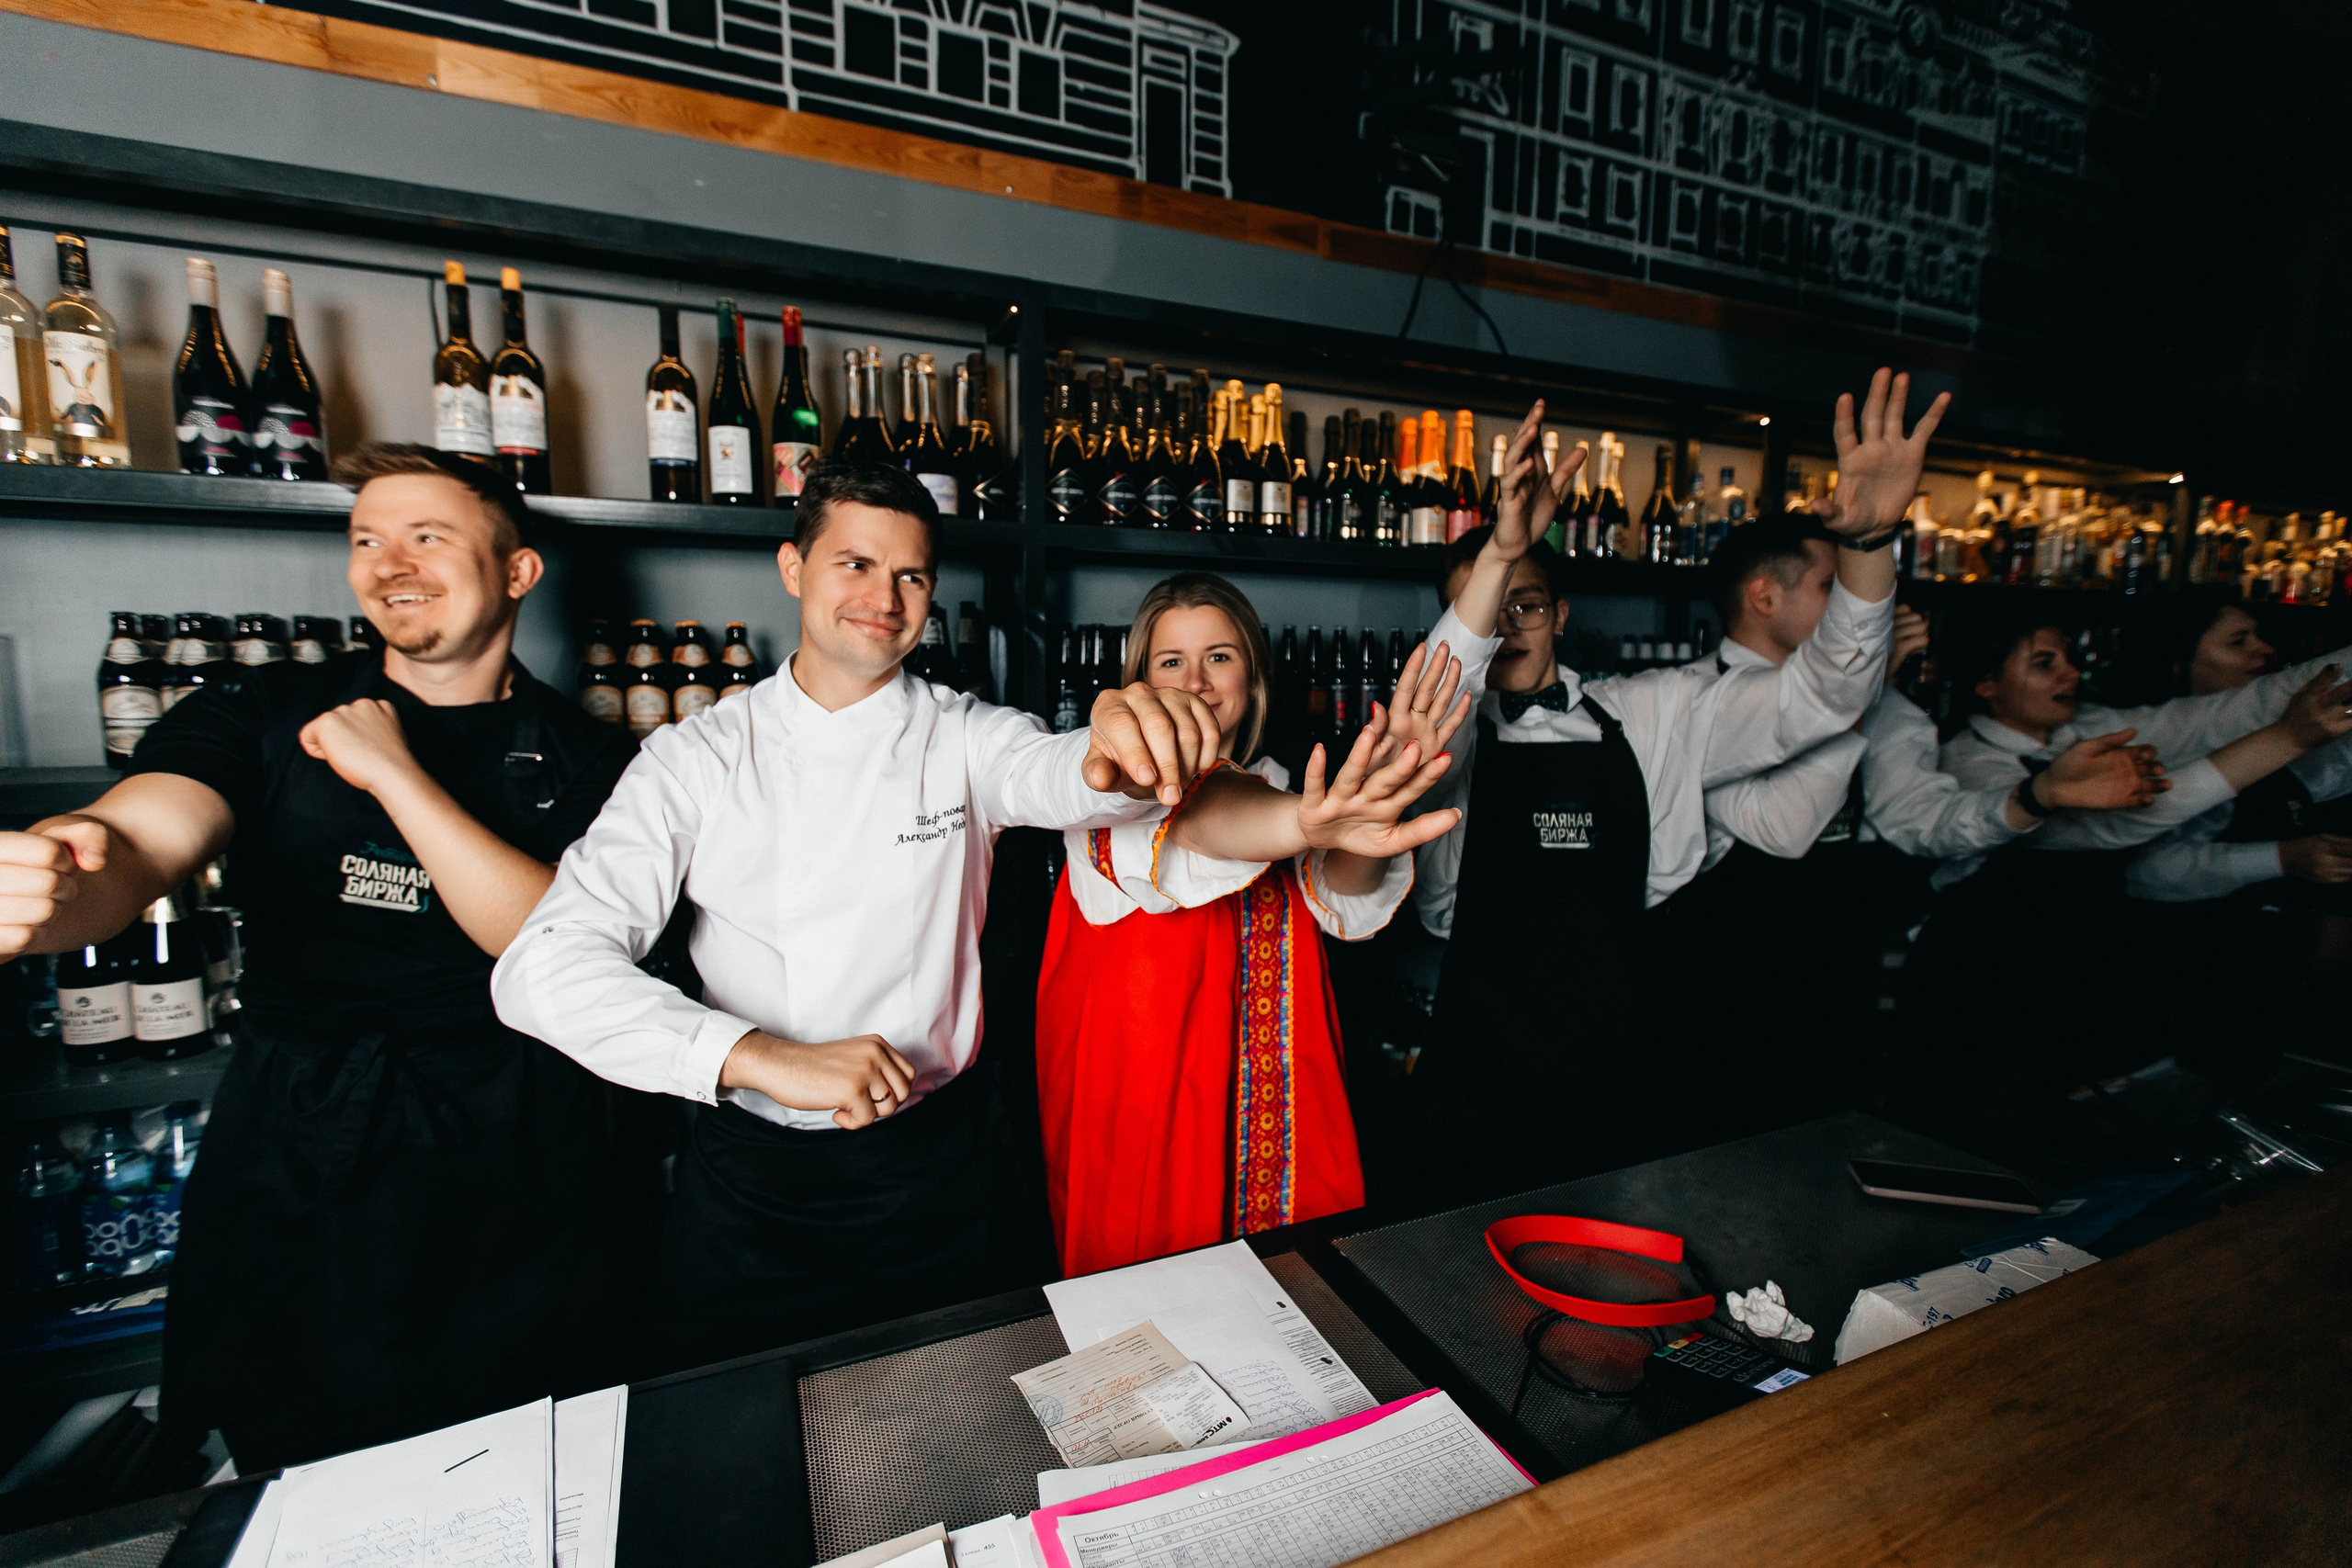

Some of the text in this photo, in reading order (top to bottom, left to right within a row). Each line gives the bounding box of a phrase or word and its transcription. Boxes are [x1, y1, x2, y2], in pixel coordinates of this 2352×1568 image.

[915, 804, 966, 828] Шеф-пова
[1532, 812, 1593, 828] СОЛЯНАЯ
[895, 826, 948, 846] Александр
[1540, 828, 1589, 842] БИРЖА
[340, 853, 431, 889] СОЛЯНАЯ
[344, 875, 419, 905] БИРЖА
[1131, 1408, 1154, 1422] ССОВЫЙ
[1203, 1419, 1228, 1437] МТС
[1084, 1532, 1120, 1544] Октябрь
